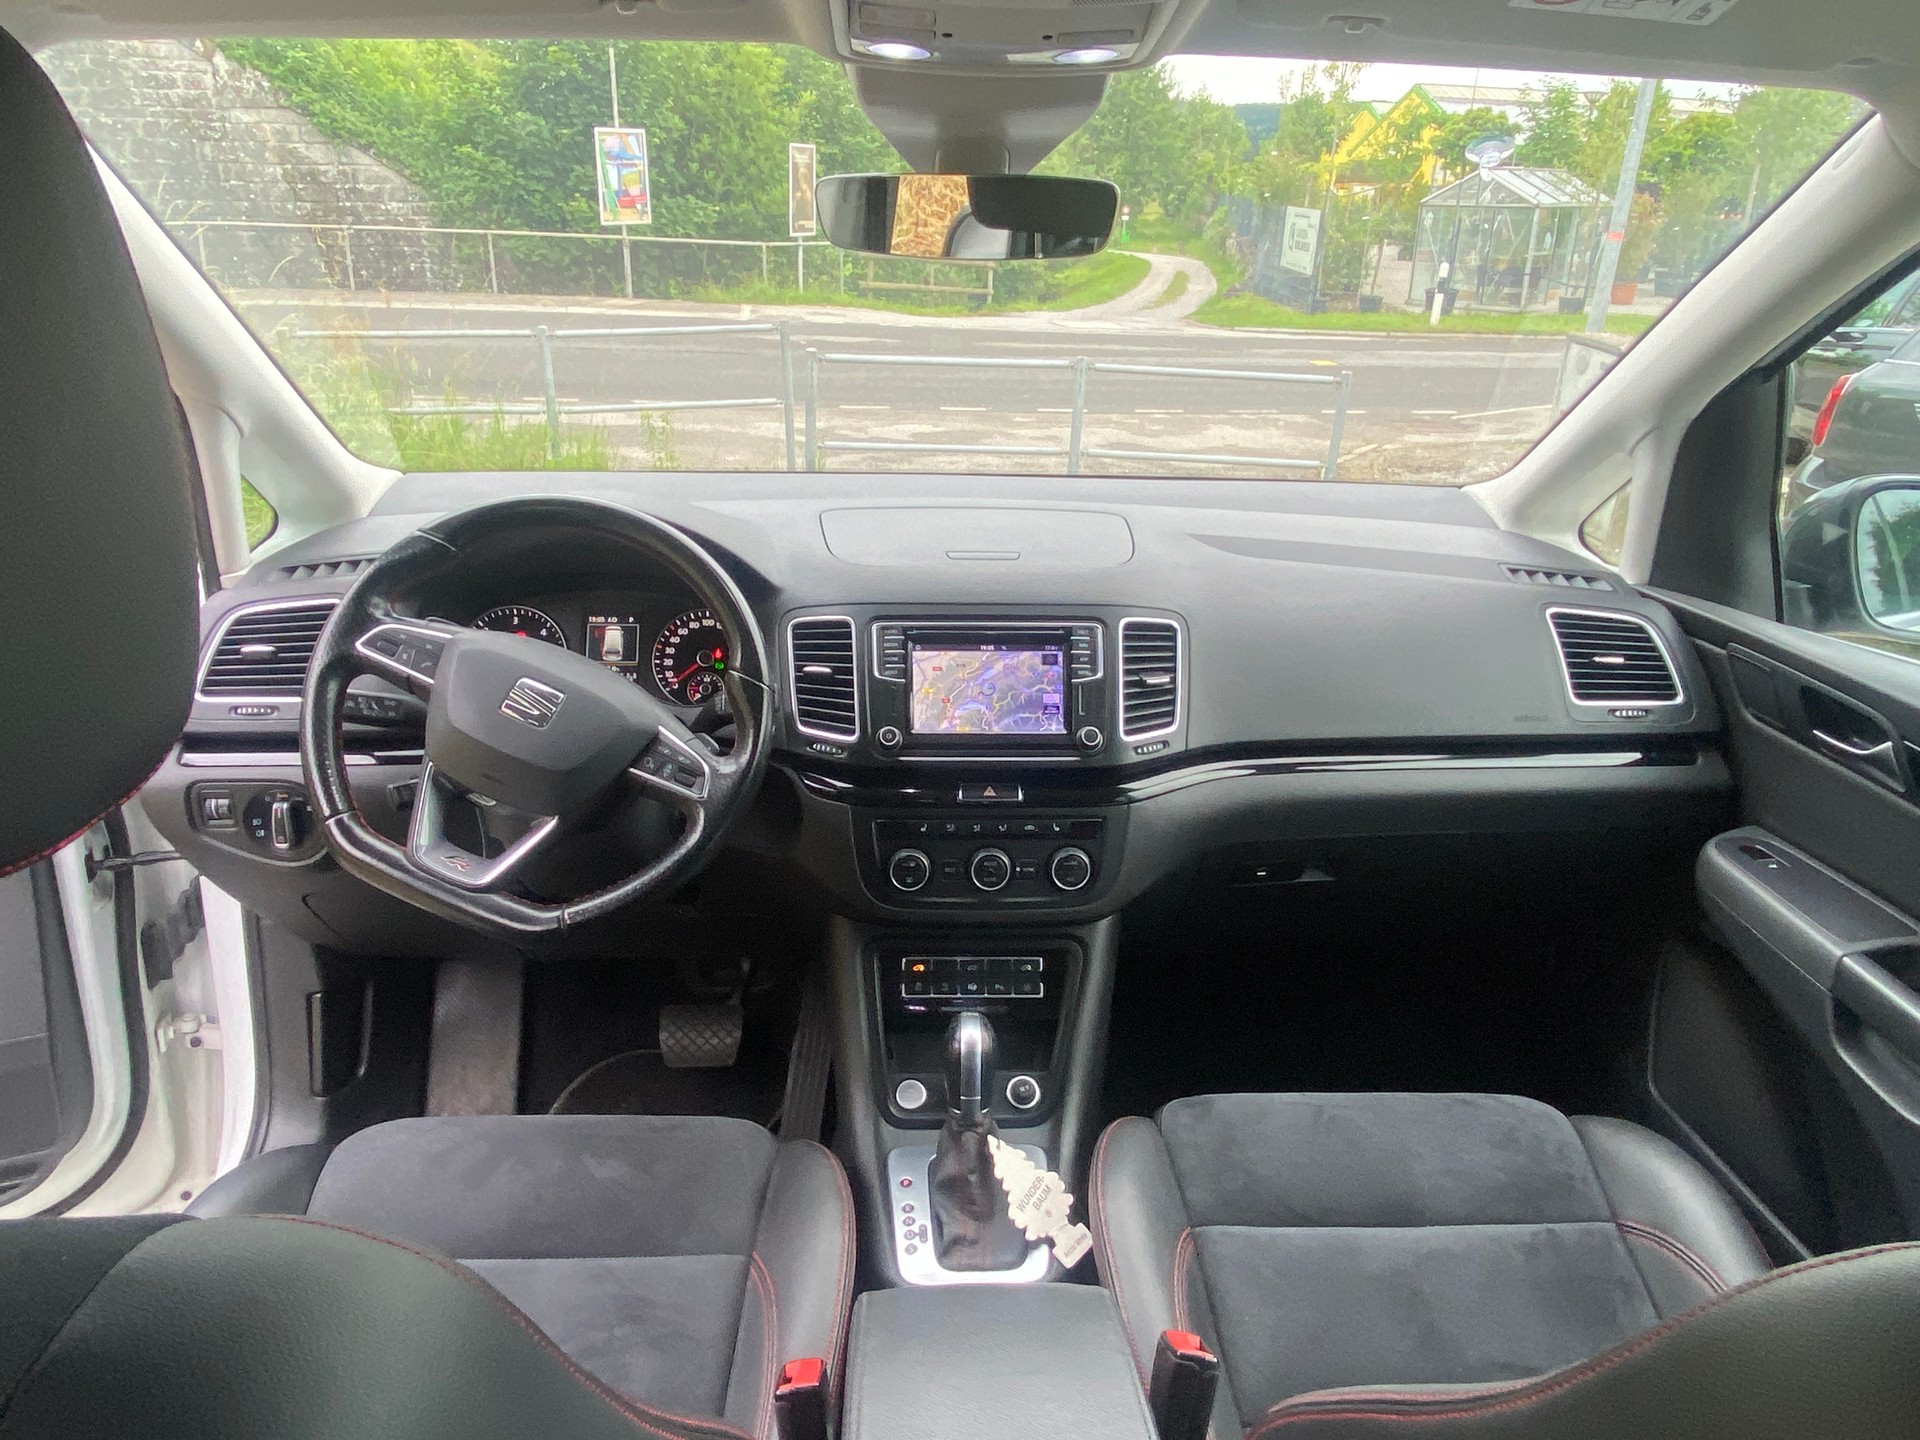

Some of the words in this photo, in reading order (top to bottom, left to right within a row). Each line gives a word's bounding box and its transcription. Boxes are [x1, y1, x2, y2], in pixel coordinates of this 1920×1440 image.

[512, 616, 519, 625] 3
[689, 621, 700, 629] 80
[540, 628, 547, 637] 4
[665, 646, 675, 654] 30
[663, 658, 673, 666] 20
[1016, 1175, 1045, 1212] WUNDER-
[1032, 1185, 1052, 1211] BAUM
